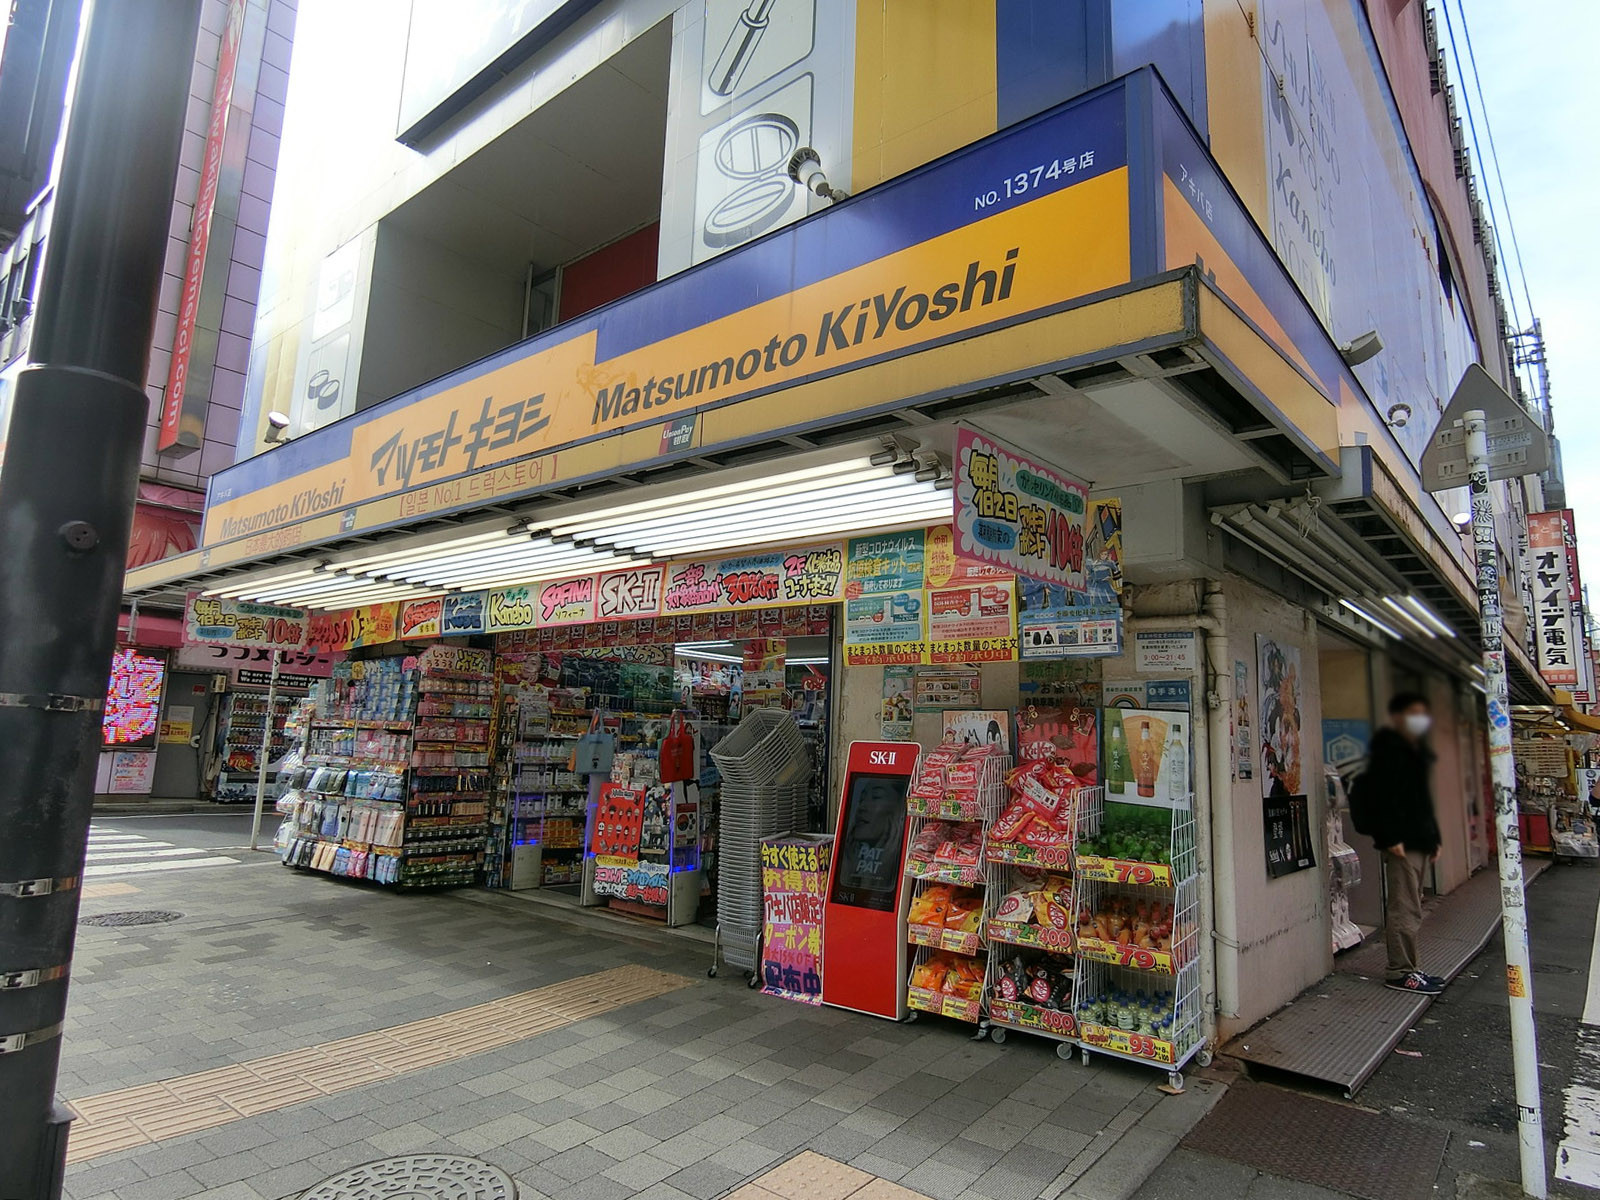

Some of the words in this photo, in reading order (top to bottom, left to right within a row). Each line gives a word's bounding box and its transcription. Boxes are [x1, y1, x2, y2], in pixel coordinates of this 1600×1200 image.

[1180, 163, 1213, 222] アキバ店
[1276, 152, 1336, 287] Kanebo
[591, 332, 808, 425] Matsumoto
[814, 247, 1020, 357] KiYoshi
[370, 393, 551, 490] マツモトキヨシ
[220, 502, 288, 540] Matsumoto
[290, 478, 347, 519] KiYoshi
[855, 537, 916, 558] 新型コロナウイルス
[490, 592, 533, 627] Kanebo
[541, 579, 593, 622] SOFINA
[1535, 551, 1570, 666] オヤイデ電気
[847, 642, 926, 657] まとまった数量のご注文
[930, 638, 1018, 653] まとまった数量のご注文
[869, 751, 897, 765] SK-II
[761, 841, 818, 871] 今すぐ使える
[856, 859, 882, 875] PAT
[858, 847, 883, 862] PAT
[1037, 846, 1068, 865] 400
[763, 868, 819, 895] お得な
[1114, 862, 1154, 884] 79
[764, 892, 822, 925] アキバ店限定
[764, 922, 821, 955] クーポン券
[1037, 927, 1072, 947] 400
[1115, 944, 1156, 969] 79
[764, 960, 823, 994] 配布中
[1041, 1011, 1074, 1031] 400
[1129, 1033, 1157, 1057] 93
